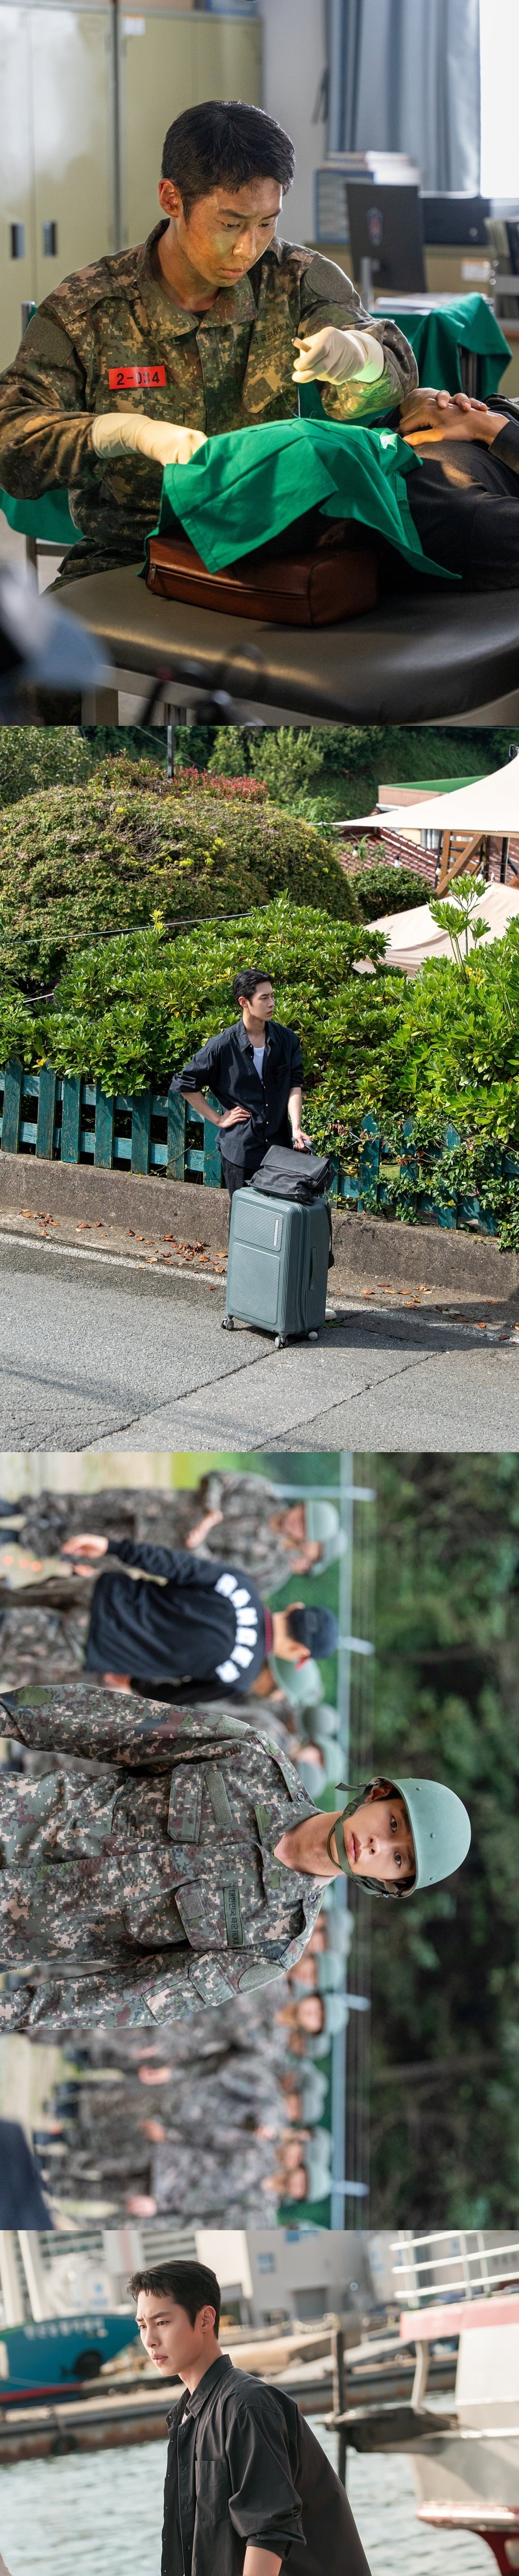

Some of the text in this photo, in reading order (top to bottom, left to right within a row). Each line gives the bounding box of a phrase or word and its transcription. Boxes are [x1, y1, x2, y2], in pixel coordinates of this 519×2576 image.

[273, 322, 291, 336] ROKA
[116, 371, 160, 385] 2-034
[228, 1890, 236, 1916] 대한민국
[231, 1917, 238, 1930] 육군
